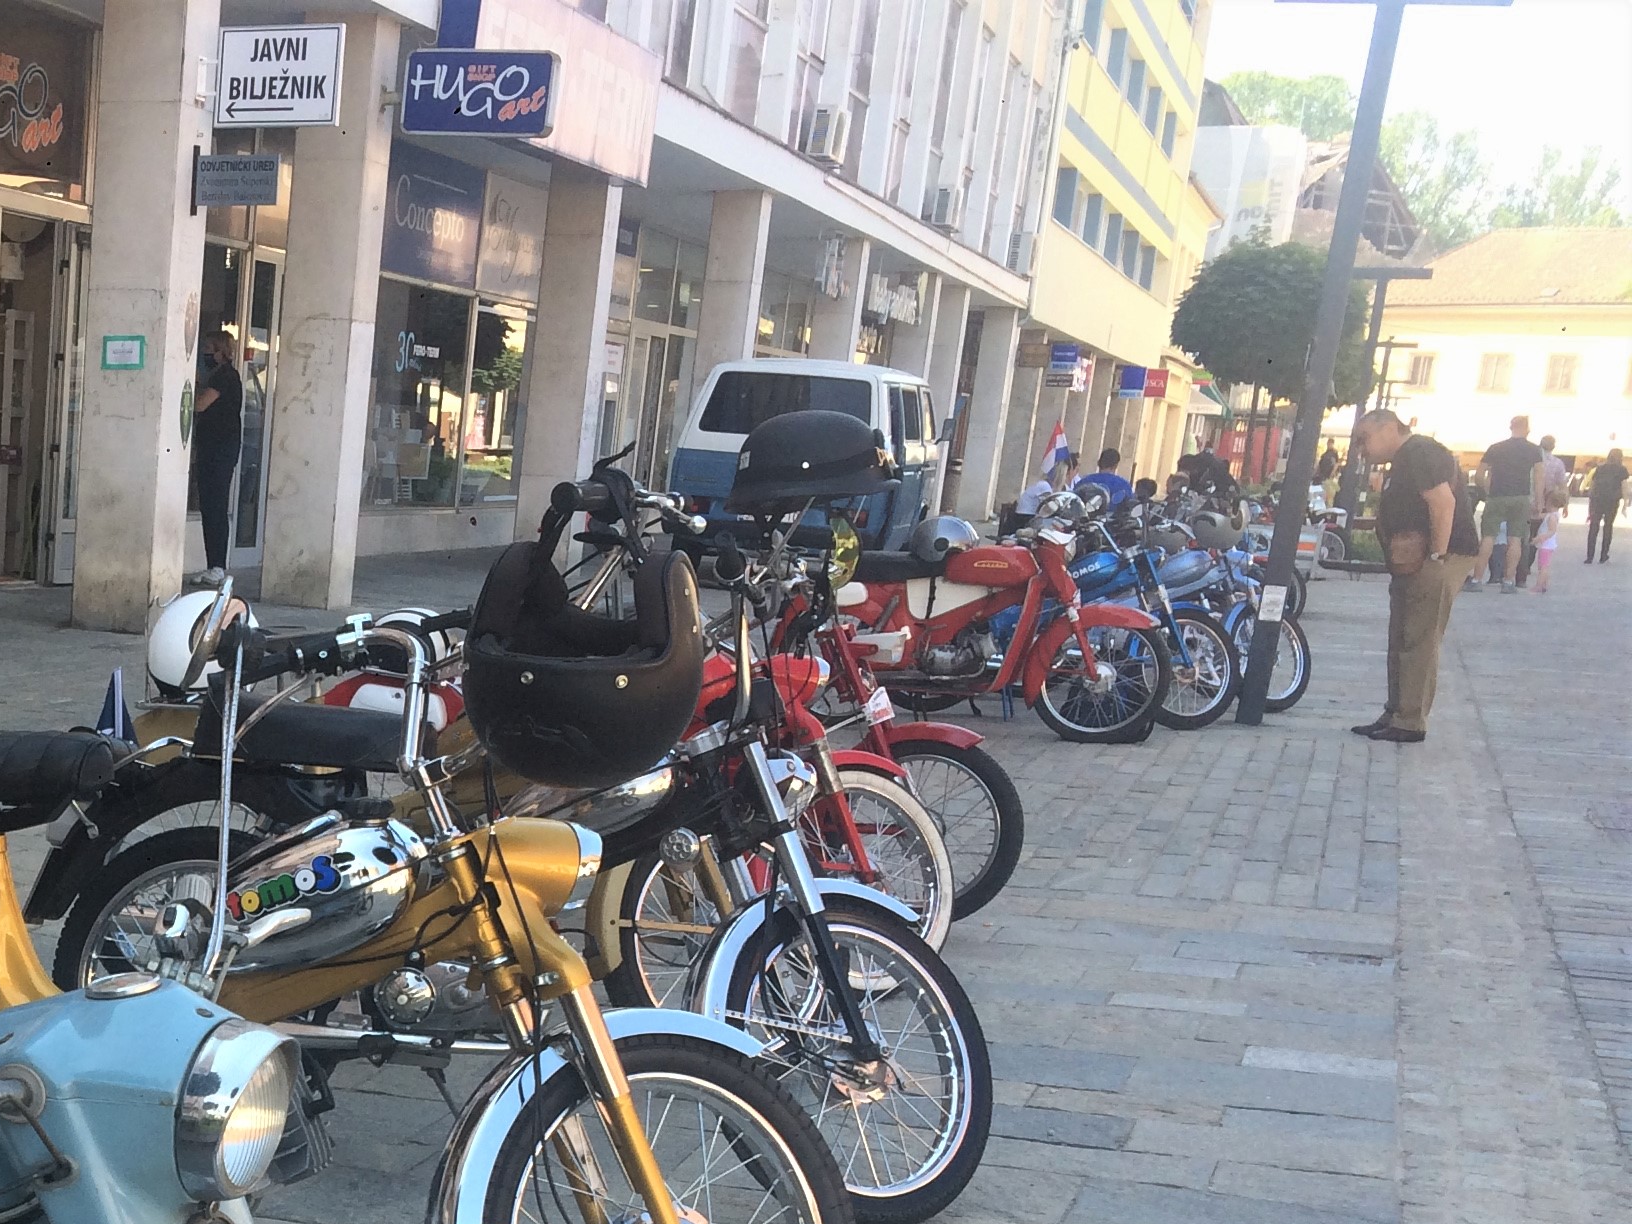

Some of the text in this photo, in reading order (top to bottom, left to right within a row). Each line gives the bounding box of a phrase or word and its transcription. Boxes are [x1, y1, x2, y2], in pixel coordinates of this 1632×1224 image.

[250, 37, 308, 62] JAVNI
[229, 67, 327, 100] BILJEŽNIK
[411, 64, 530, 119] HUGO
[498, 86, 546, 122] art
[21, 103, 63, 153] art
[200, 158, 275, 172] ODVJETNIČKI URED
[394, 174, 465, 249] Concepto
[1071, 561, 1101, 579] OMOS
